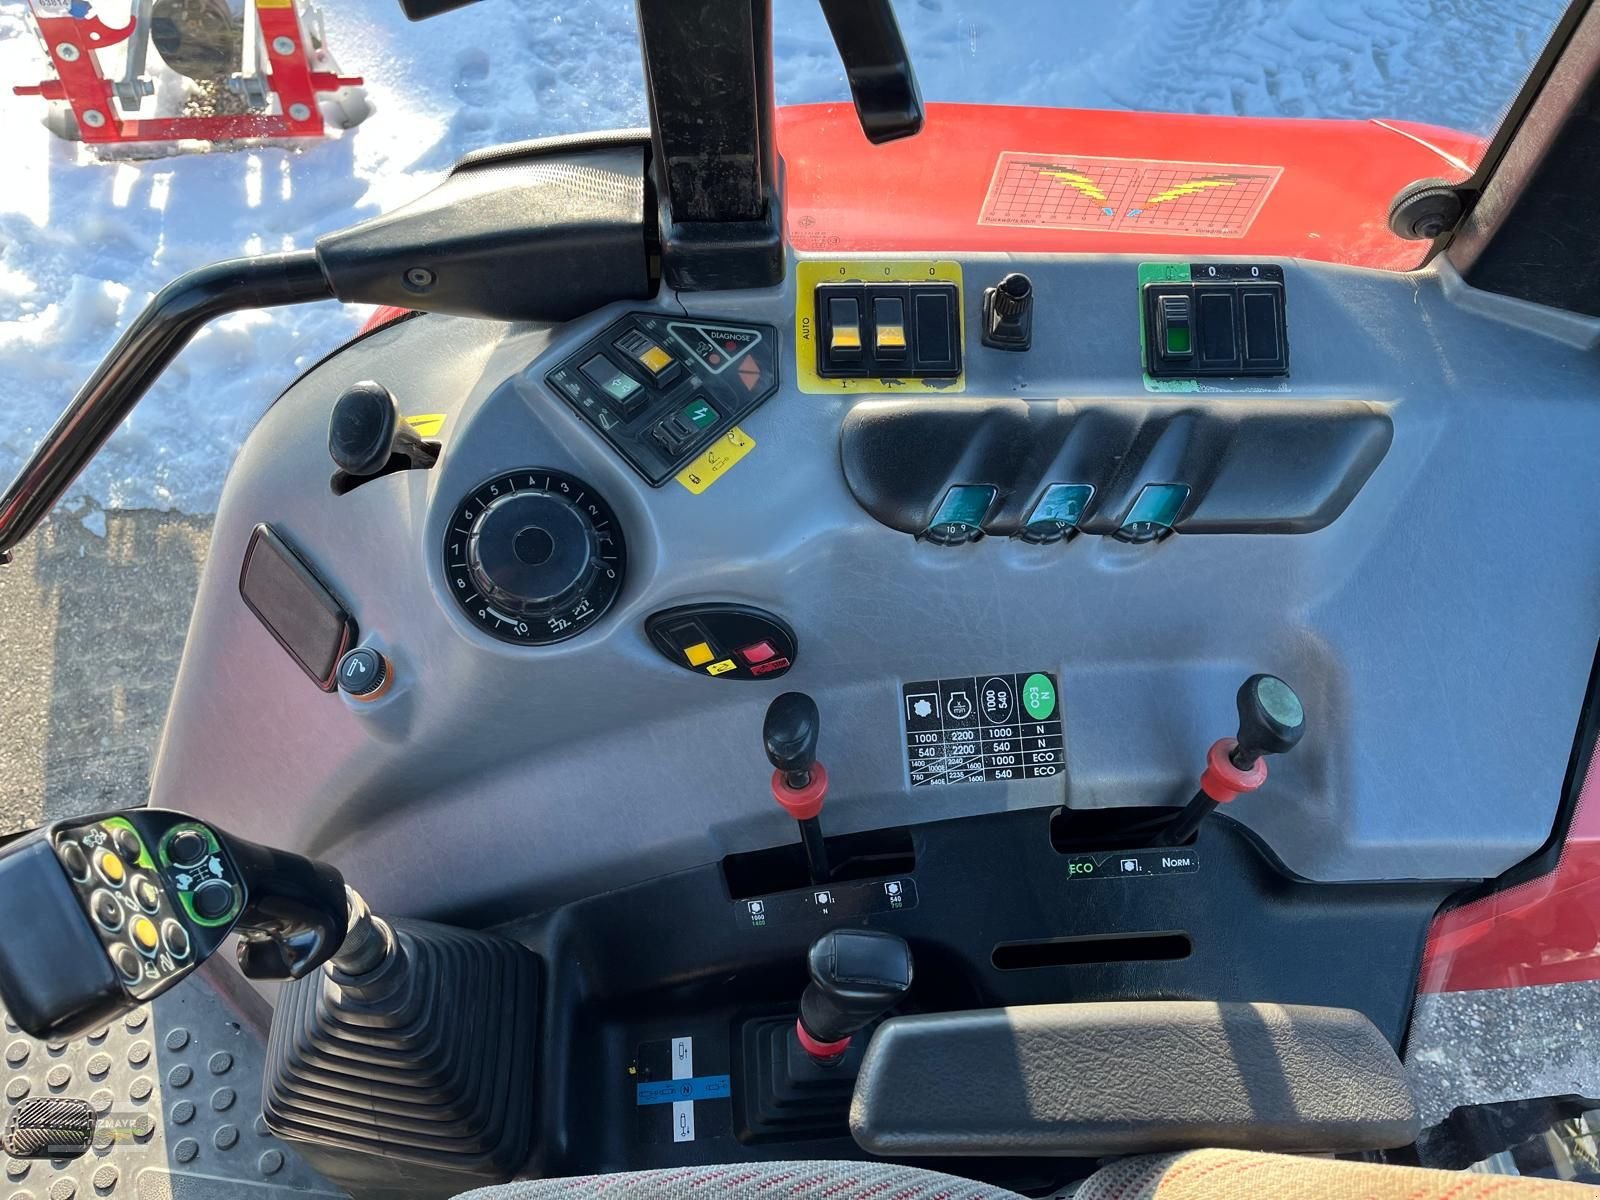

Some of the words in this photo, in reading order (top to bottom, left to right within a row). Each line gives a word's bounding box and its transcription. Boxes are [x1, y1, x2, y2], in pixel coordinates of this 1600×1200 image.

[840, 267, 846, 275] 0
[929, 267, 935, 275] 0
[1208, 266, 1216, 276] 0
[1251, 266, 1259, 276] 0
[802, 318, 810, 340] AUTO
[711, 332, 751, 342] DIAGNOSE
[528, 476, 536, 486] 4
[490, 484, 499, 496] 5
[561, 482, 570, 494] 3
[465, 510, 473, 520] 6
[588, 504, 598, 516] 2
[946, 526, 956, 534] 10
[1145, 522, 1150, 530] 7
[451, 544, 459, 556] 7
[606, 568, 616, 578] 0
[456, 578, 466, 588] 8
[478, 609, 486, 620] 9
[514, 622, 528, 636] 10
[986, 690, 996, 712] 1000
[998, 692, 1008, 709] 540
[1030, 686, 1040, 708] ECO
[1041, 692, 1050, 700] N
[914, 734, 938, 744] 1000
[952, 730, 974, 741] 2200
[988, 728, 1012, 738] 1000
[1036, 726, 1044, 734] N
[918, 748, 936, 757] 540
[952, 744, 974, 755] 2200
[993, 742, 1010, 752] 540
[1038, 739, 1046, 748] N
[991, 756, 1014, 766] 1000
[1032, 752, 1054, 762] ECO
[995, 769, 1012, 778] 540
[1034, 766, 1056, 776] ECO
[1069, 863, 1094, 874] ECO
